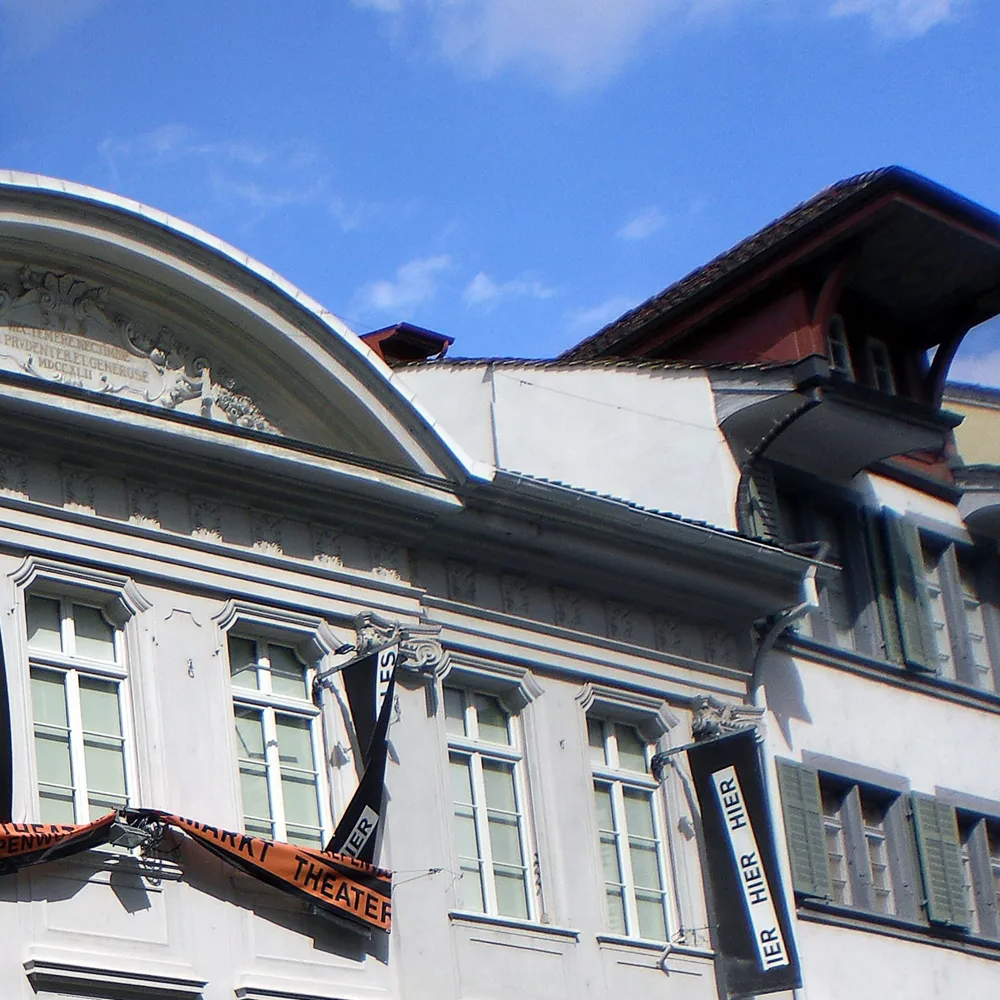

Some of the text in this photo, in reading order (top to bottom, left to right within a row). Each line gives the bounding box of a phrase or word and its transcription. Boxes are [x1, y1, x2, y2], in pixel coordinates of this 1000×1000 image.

[721, 778, 747, 830] HIER
[294, 855, 391, 923] THEATER
[741, 852, 767, 905] HIER
